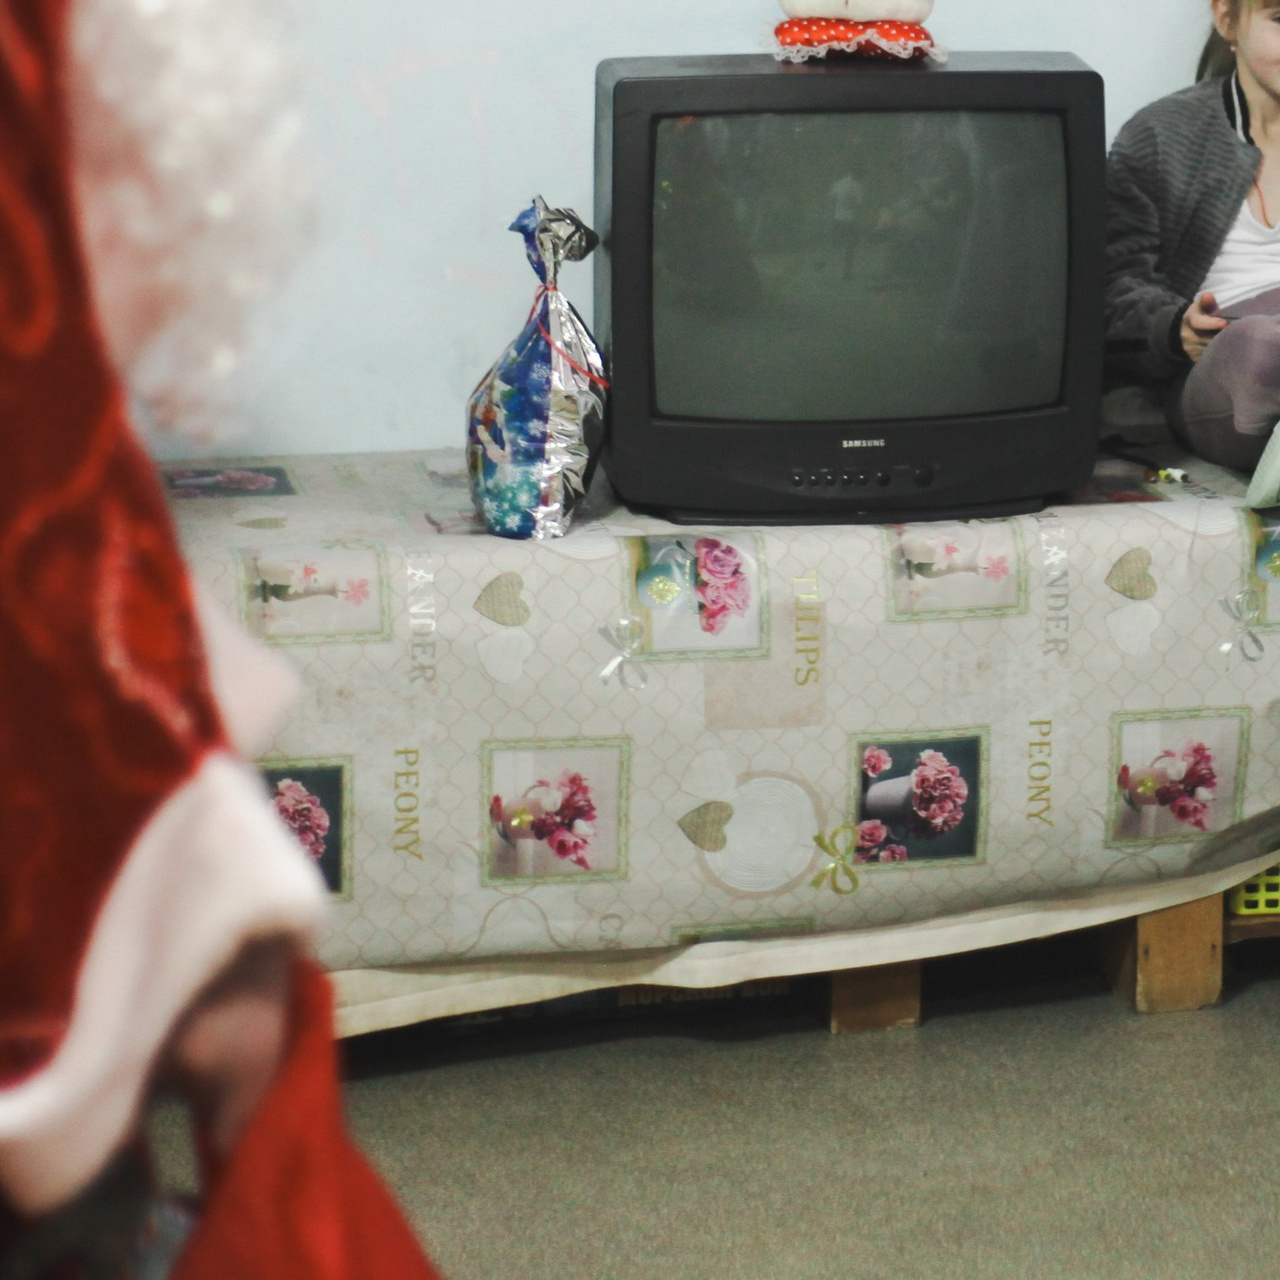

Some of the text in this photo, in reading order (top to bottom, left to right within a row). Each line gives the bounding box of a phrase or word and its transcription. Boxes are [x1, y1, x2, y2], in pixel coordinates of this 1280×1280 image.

[842, 439, 886, 448] SAMSUNG
[794, 568, 821, 686] TULIPS
[393, 747, 425, 861] PEONY
[1025, 720, 1055, 827] PEONY
